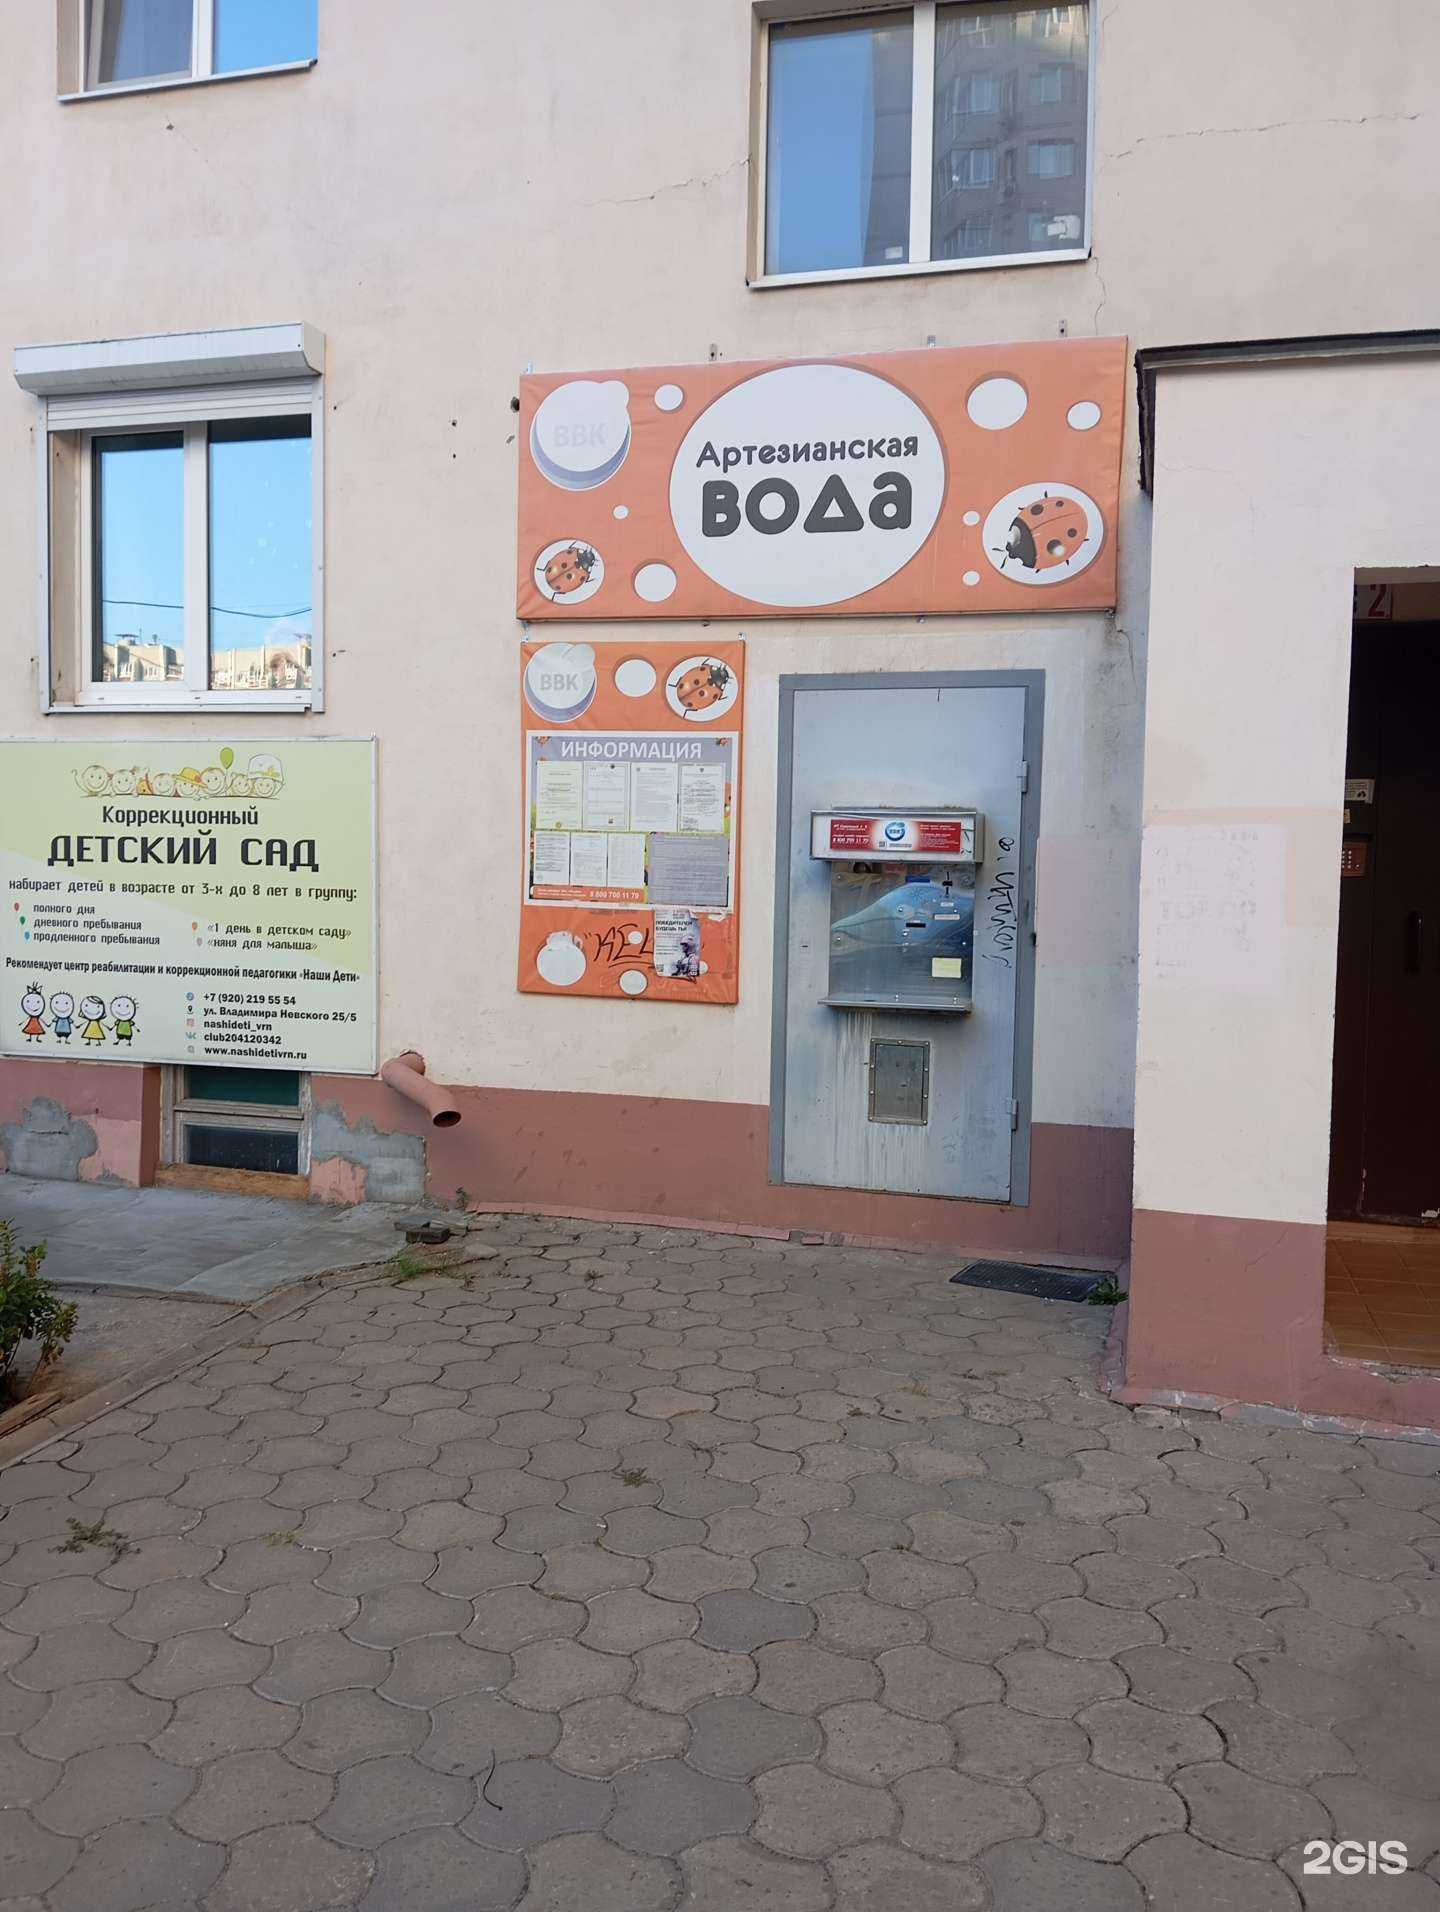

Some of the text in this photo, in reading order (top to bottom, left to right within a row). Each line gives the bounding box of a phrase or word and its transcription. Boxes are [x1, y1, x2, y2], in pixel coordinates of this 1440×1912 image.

[696, 436, 918, 473] Артезианская
[561, 741, 702, 761] ИНФОРМАЦИЯ
[103, 806, 258, 827] Коррекционный
[48, 829, 319, 872] ДЕТСКИЙ САД
[10, 878, 356, 901] набирает детей в возрасте от 3-х до 8 лет в группу:
[34, 905, 94, 915] полного дня
[34, 919, 141, 930] дневного пребывания
[226, 925, 251, 934] день
[268, 927, 313, 935] детском
[34, 933, 160, 944] продленного пребывания
[242, 941, 261, 949] для
[6, 957, 62, 971] Рекомендует
[65, 962, 89, 973] центр
[92, 961, 155, 974] реабилитации
[166, 966, 239, 977] коррекционной
[243, 969, 296, 979] педагогики
[204, 993, 296, 1005] +7 (920) 219 55 54
[204, 1007, 356, 1022] ул. Владимира Невского 25/5
[204, 1020, 272, 1032] nashideti_vrn
[204, 1033, 281, 1044] club204120342
[205, 1048, 306, 1059] www.nashidetivrn.ru
